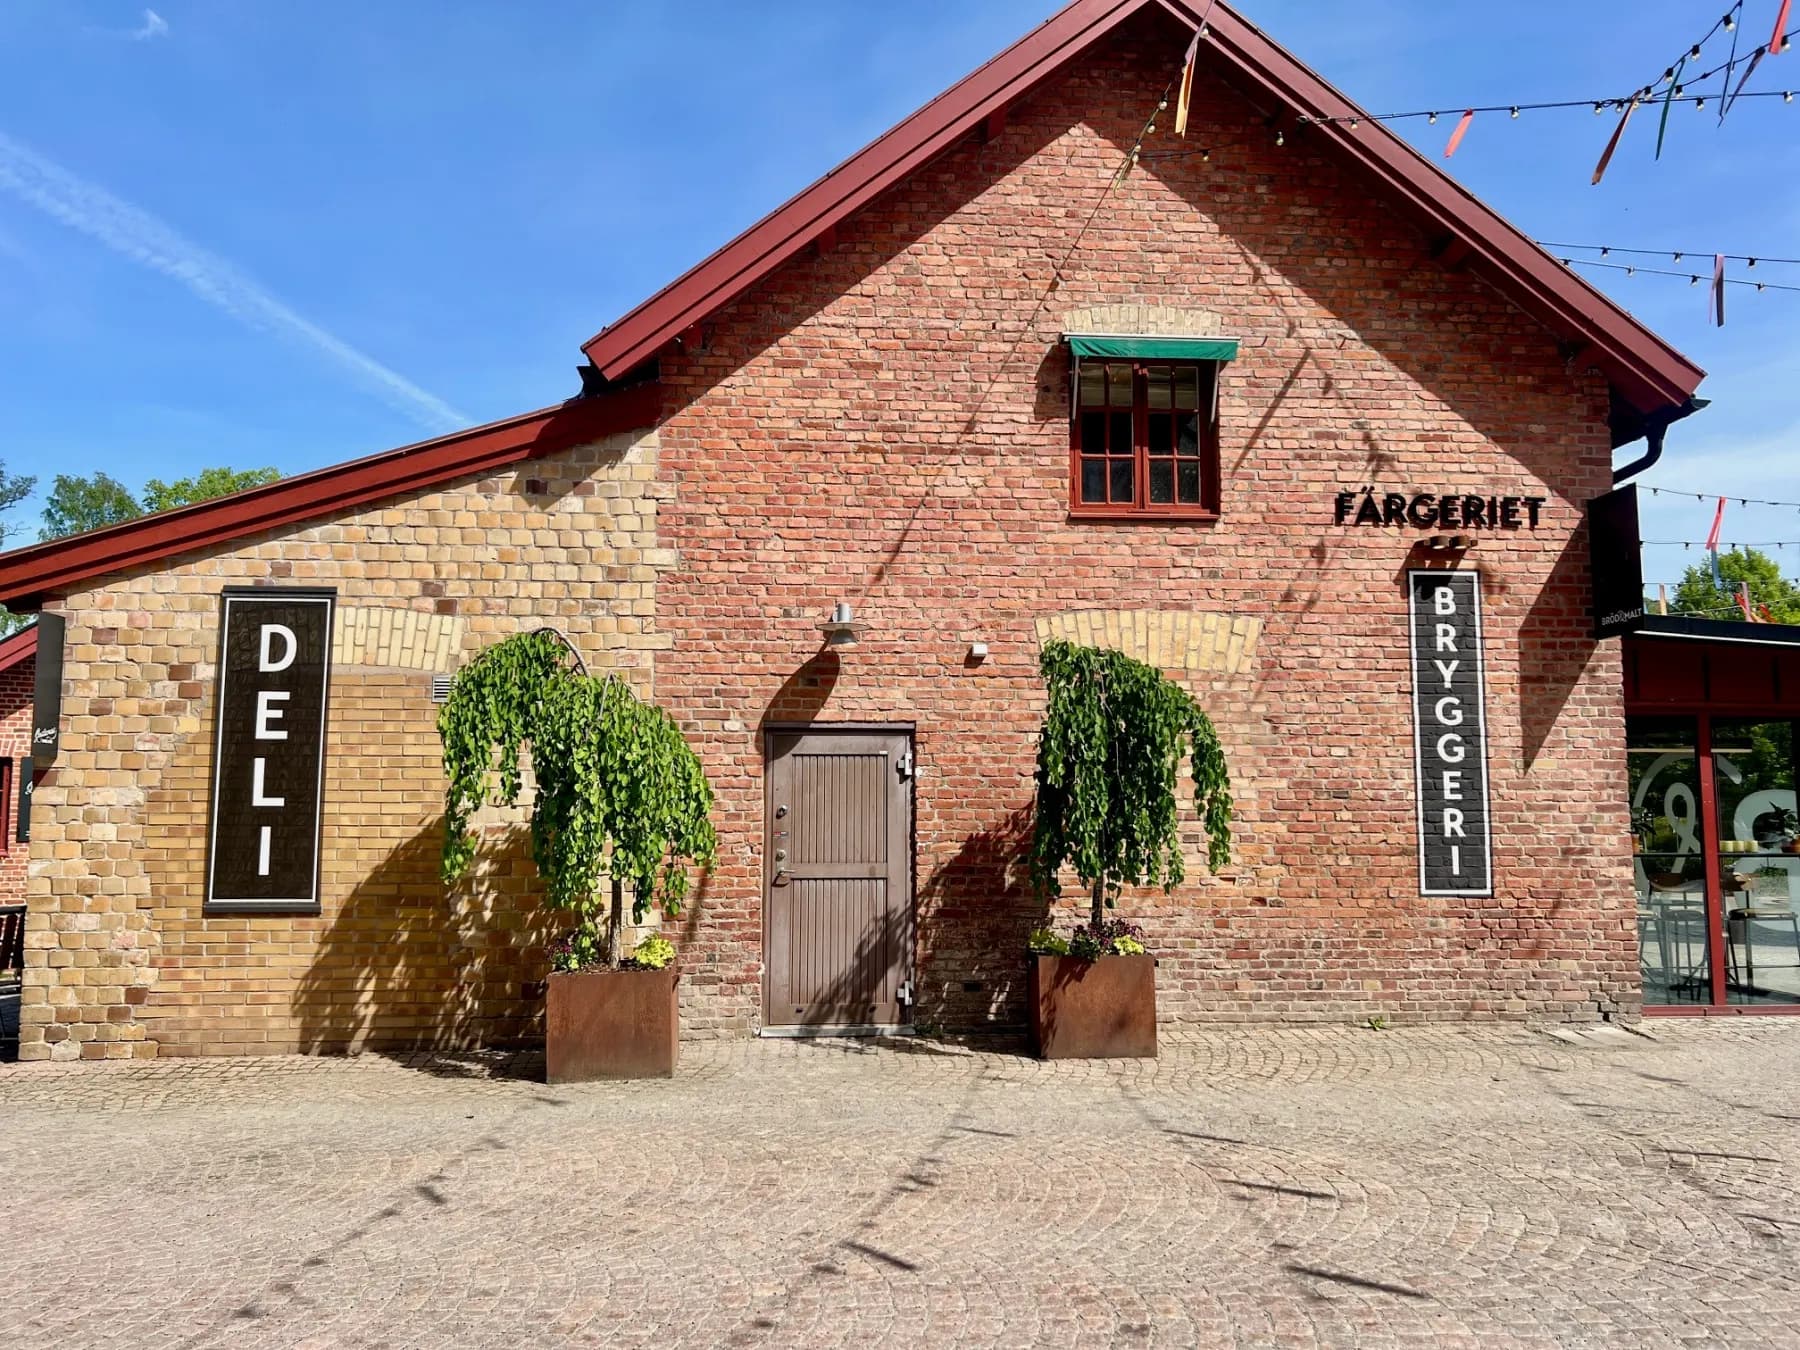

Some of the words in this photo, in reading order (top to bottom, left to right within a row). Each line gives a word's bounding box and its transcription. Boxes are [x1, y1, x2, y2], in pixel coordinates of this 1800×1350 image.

[1336, 486, 1546, 527] FÄRGERIET
[252, 624, 298, 876] DELI
[1434, 586, 1466, 876] BRYGGERI
